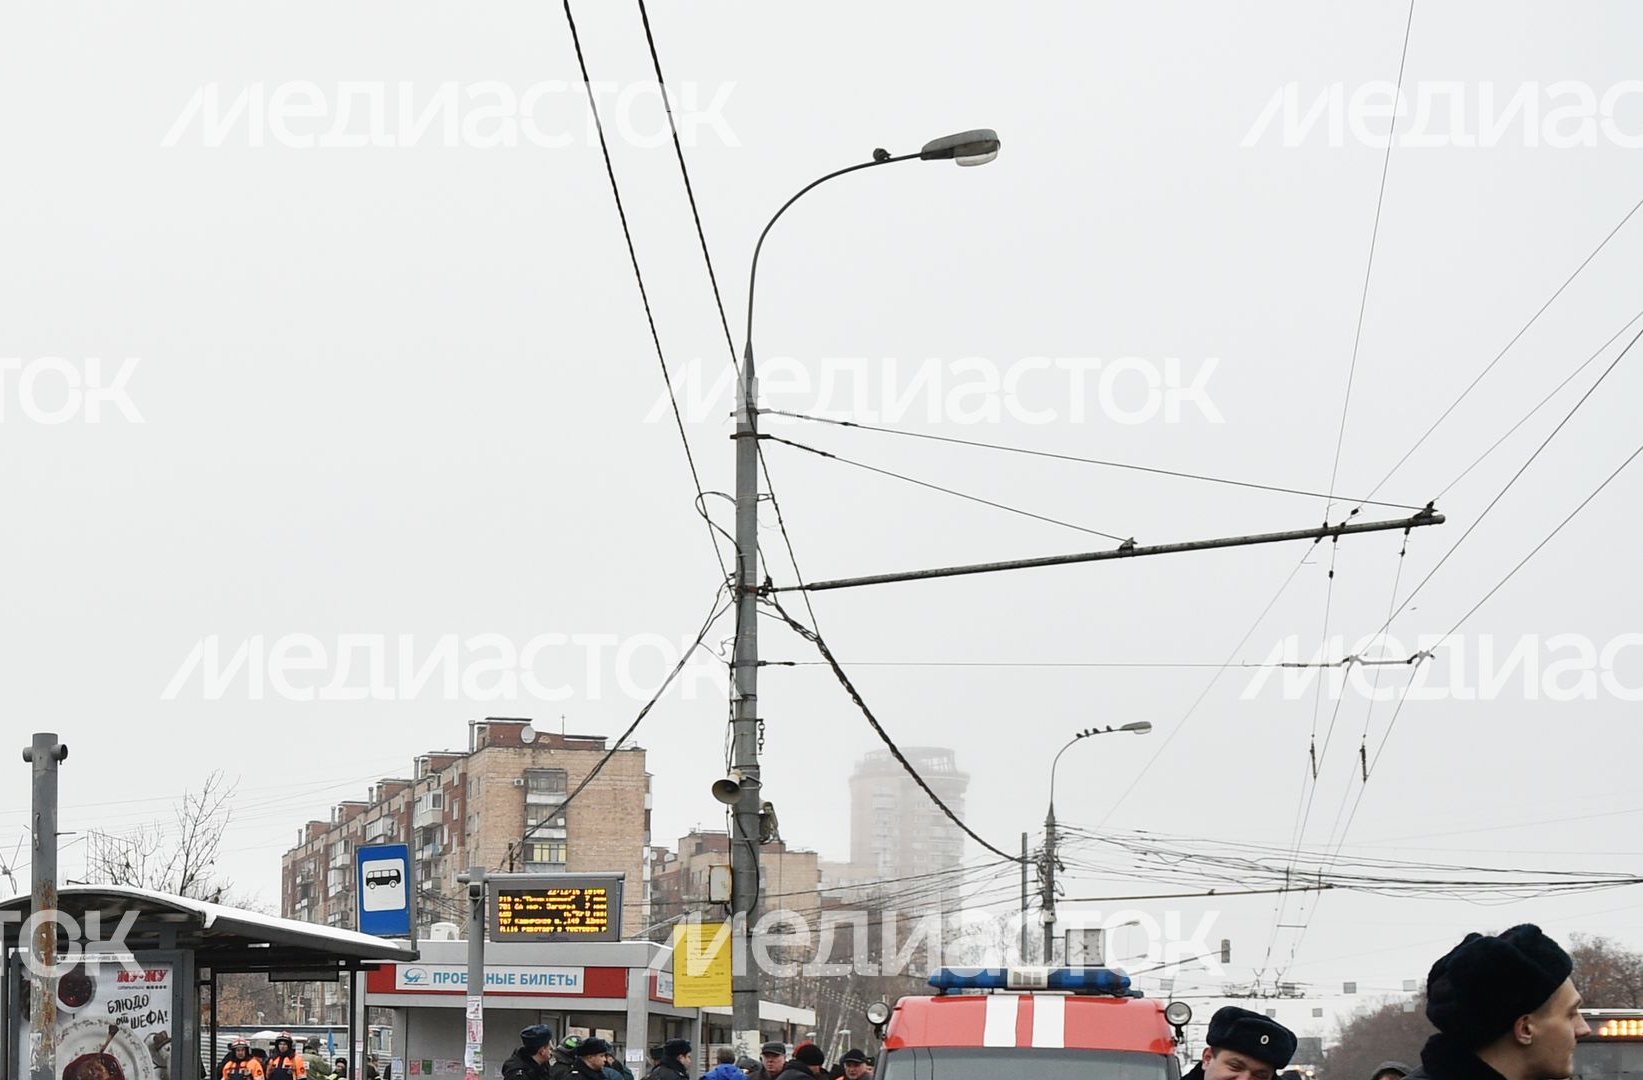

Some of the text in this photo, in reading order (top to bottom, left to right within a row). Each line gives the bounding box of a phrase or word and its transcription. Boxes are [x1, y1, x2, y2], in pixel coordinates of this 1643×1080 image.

[433, 972, 578, 987] ПРОЕНЫЕ БИЛЕТЫ
[107, 994, 149, 1014] БЛЮДО
[130, 1009, 169, 1029] ШЕФА!
